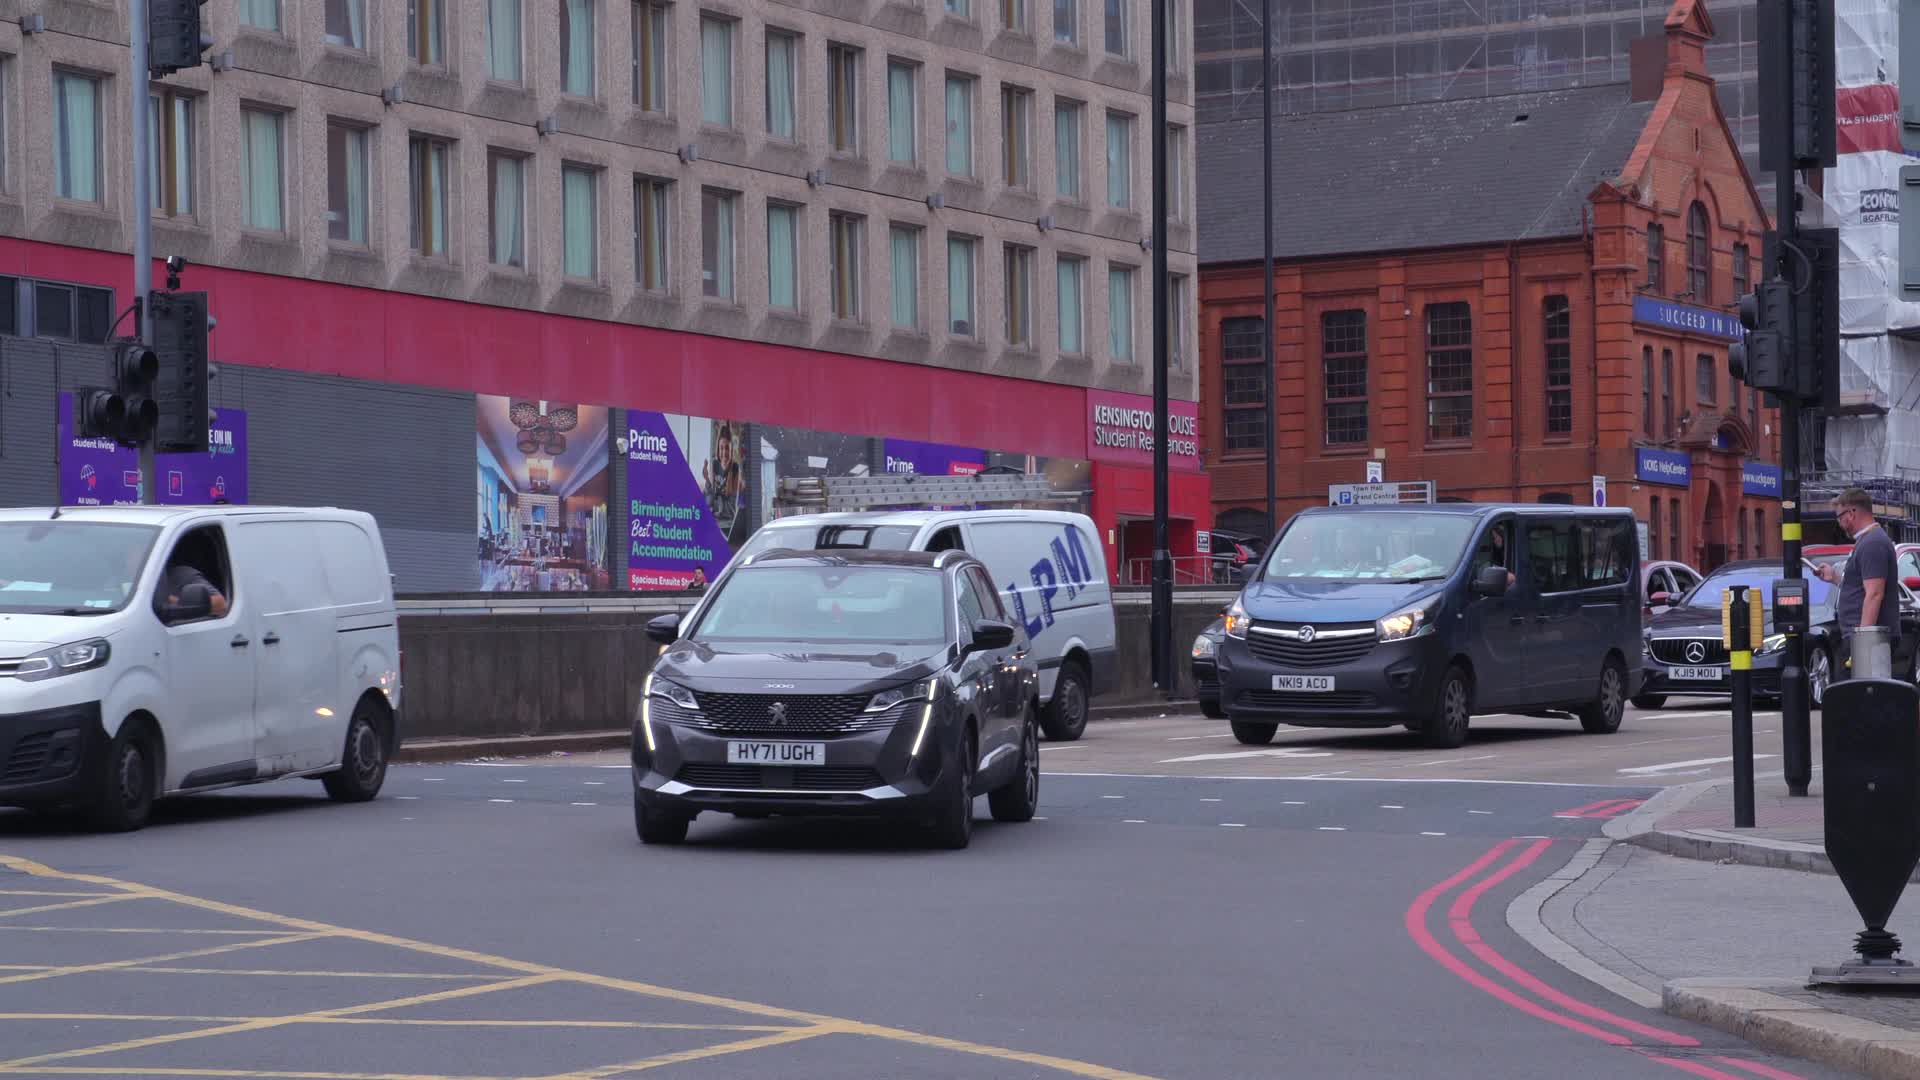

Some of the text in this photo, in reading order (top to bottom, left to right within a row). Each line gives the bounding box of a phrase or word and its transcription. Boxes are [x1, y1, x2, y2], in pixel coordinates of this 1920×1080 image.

[1854, 113, 1892, 124] STUDENT
[1659, 307, 1706, 329] SUCCEED
[1712, 316, 1723, 333] IN
[1095, 404, 1196, 436] KENSINGTO OUSE
[73, 439, 115, 452] student living
[630, 429, 668, 452] Prime
[1095, 425, 1137, 449] Student
[630, 451, 668, 464] student living
[886, 455, 914, 474] Prime
[1659, 461, 1687, 476] HelpCentre
[1373, 491, 1398, 500] Central
[631, 500, 701, 521] Birmingham's
[631, 518, 693, 541] Best Student
[631, 541, 713, 561] Accommodation
[631, 574, 658, 585] Spacious
[1006, 524, 1093, 640] LPM
[1673, 668, 1717, 678] KJ19 MOU
[1278, 676, 1328, 689] NK19 ACO
[738, 743, 815, 761] HY71 UGH
